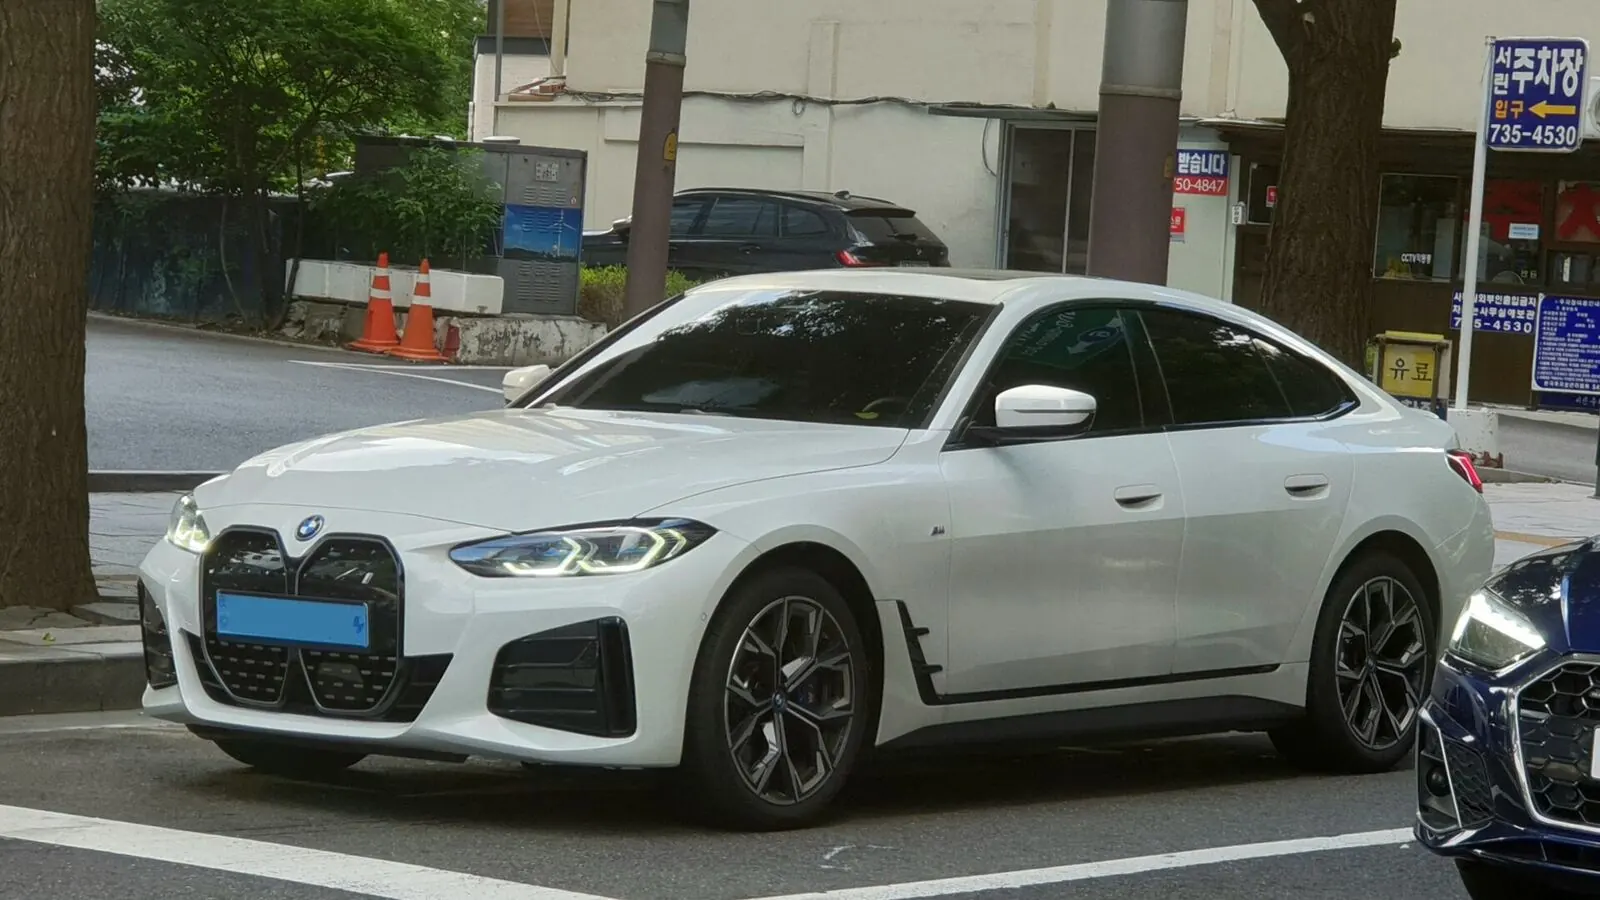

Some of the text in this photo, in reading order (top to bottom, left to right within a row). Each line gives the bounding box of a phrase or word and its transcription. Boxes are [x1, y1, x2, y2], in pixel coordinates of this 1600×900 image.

[1494, 46, 1511, 95] 서린
[1512, 46, 1583, 97] 주차장
[1495, 100, 1524, 119] 입구
[1490, 124, 1577, 145] 735-4530
[1178, 152, 1226, 175] 받습니다
[1174, 178, 1225, 193] 50-4847
[1453, 317, 1533, 333] 75-4530
[1389, 358, 1432, 381] 유료
